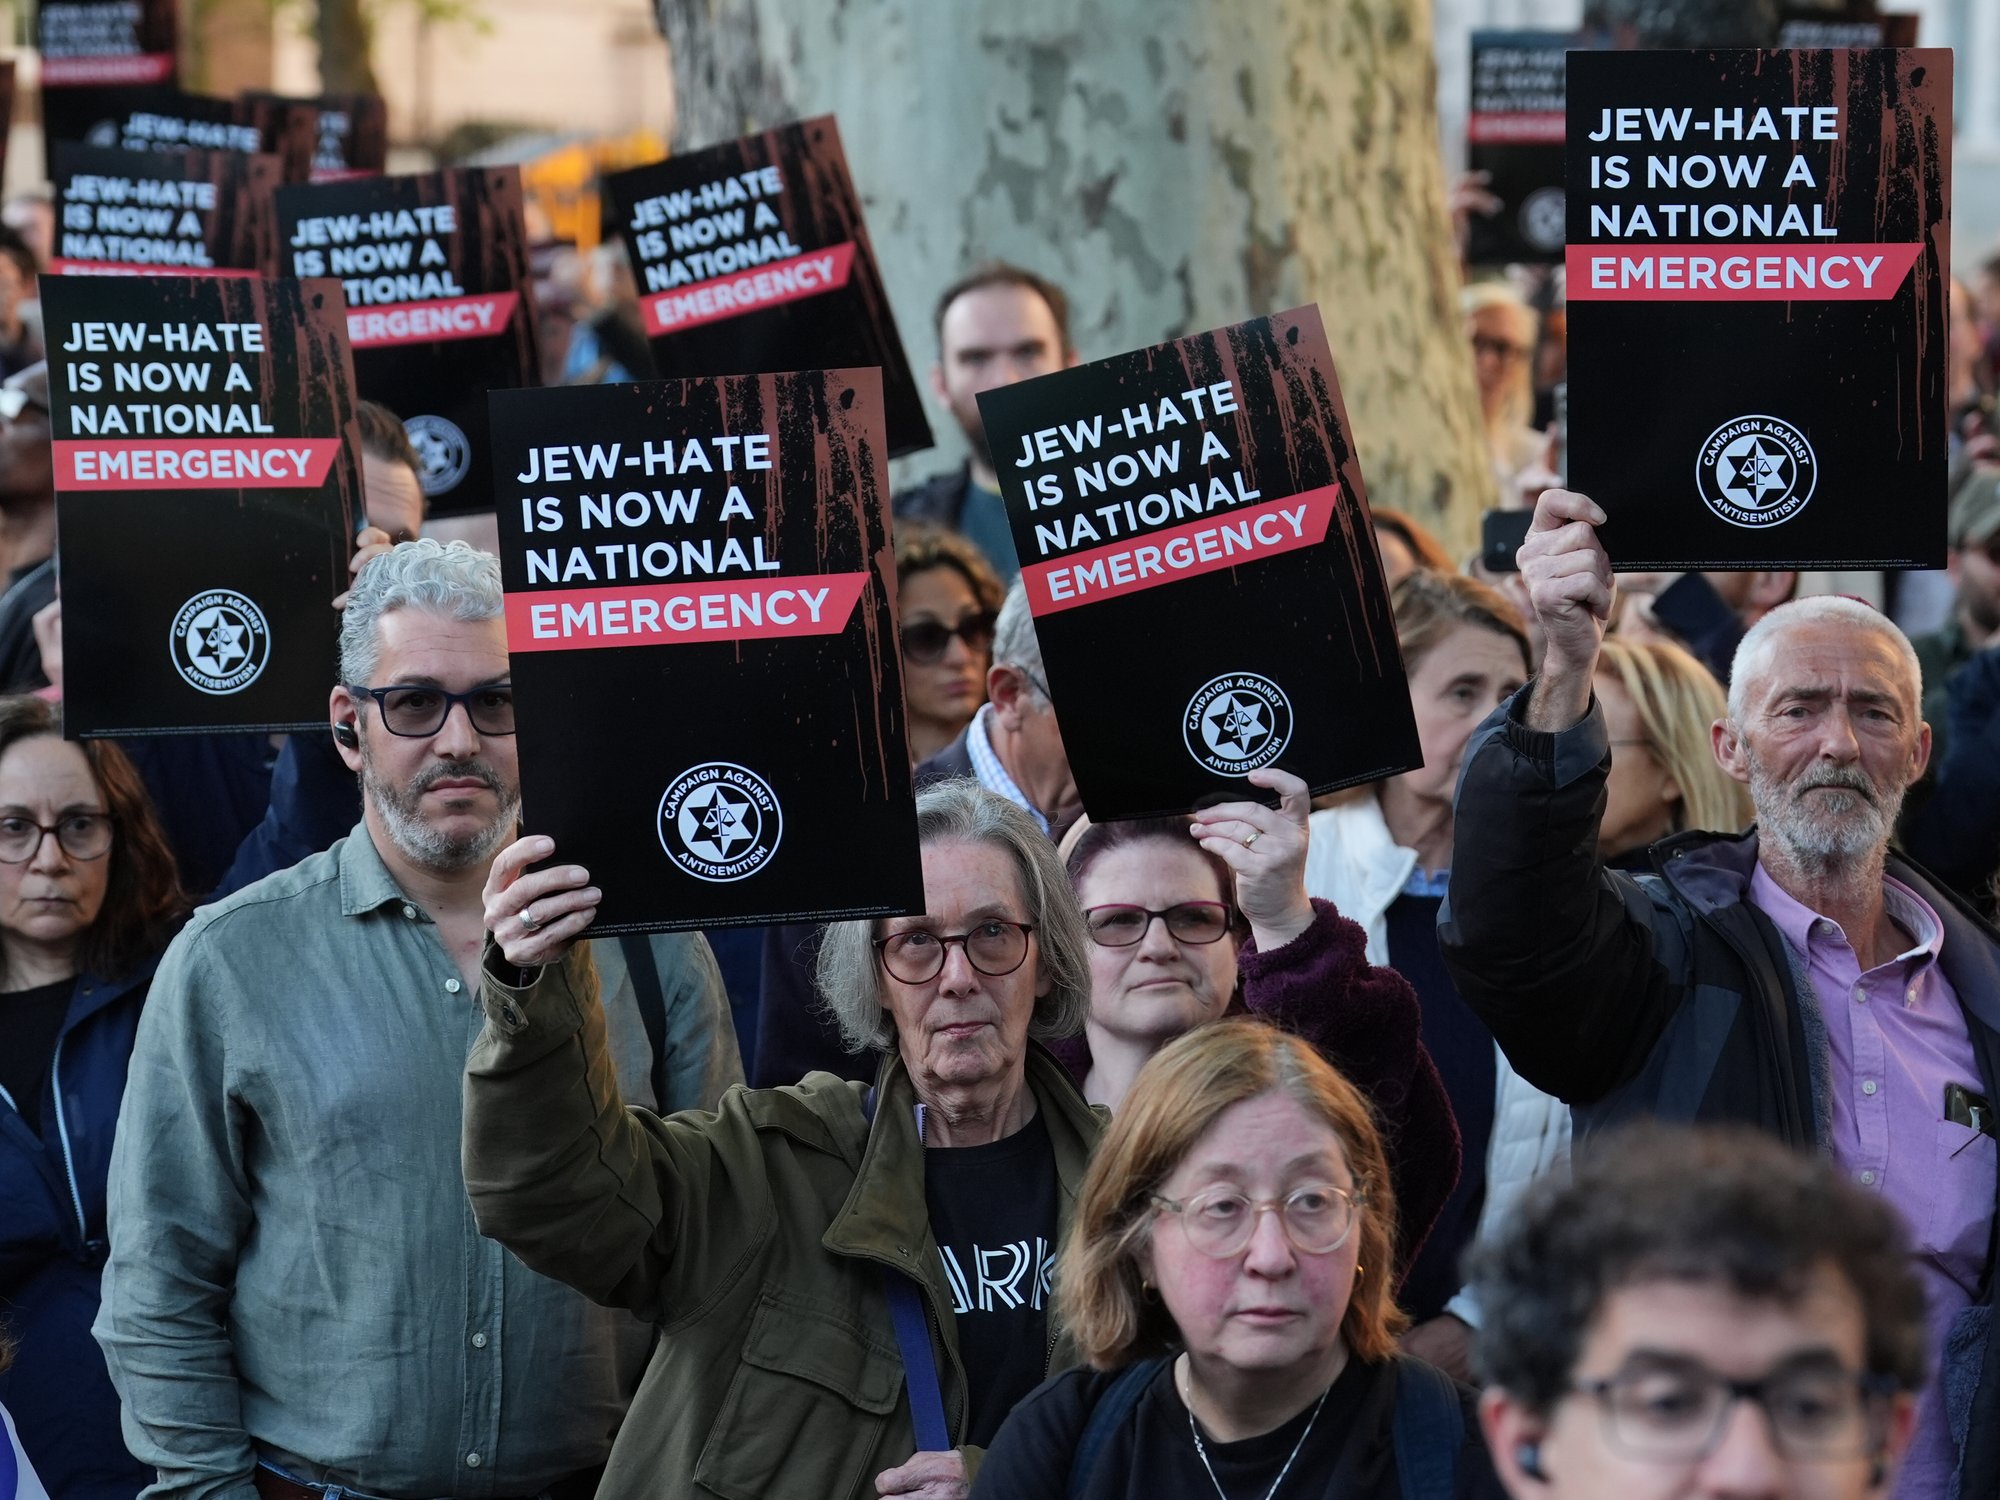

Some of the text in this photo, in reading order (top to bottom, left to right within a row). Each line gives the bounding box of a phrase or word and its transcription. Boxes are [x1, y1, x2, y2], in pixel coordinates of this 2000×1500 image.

[1588, 107, 1839, 141] JEW-HATE
[1591, 155, 1816, 188] IS NOW A
[63, 174, 218, 211] JEW-HATE
[630, 165, 783, 231] JEW-HATE
[63, 203, 202, 238] IS NOW A
[290, 204, 457, 247] JEW-HATE
[636, 201, 780, 261] IS NOW A
[1591, 204, 1838, 237] NATIONAL
[62, 232, 214, 268] NATIONAL
[293, 238, 447, 278] IS NOW A
[644, 230, 802, 292] NATIONAL
[343, 269, 464, 306] TIONAL
[654, 255, 835, 327] EMERGENCY
[1591, 256, 1884, 289] EMERGENCY
[63, 322, 265, 352] JEW-HATE
[347, 301, 496, 341] ERGENCY
[67, 362, 252, 392] IS NOW A
[70, 404, 274, 434] NATIONAL
[1015, 380, 1239, 468] JEW-HATE
[516, 434, 773, 484] JEW-HATE
[1704, 421, 1809, 467] CAMPAIGN AGAINST
[74, 449, 312, 481] EMERGENCY
[1023, 431, 1231, 511] IS NOW A
[521, 486, 754, 533] IS NOW A
[1034, 471, 1261, 555] NATIONAL
[1713, 495, 1800, 522] ANTISEMITISM
[525, 536, 780, 584] NATIONAL
[1046, 504, 1307, 601] EMERGENCY
[176, 595, 264, 638] CAMPAIGN AGAINST
[531, 587, 830, 639] EMERGENCY
[184, 662, 257, 689] ANTISEMITISM
[1189, 677, 1283, 730] CAMPAIGN AGAINST
[1205, 736, 1283, 772] ANTISEMITISM
[664, 769, 774, 819] CAMPAIGN AGAINST
[678, 845, 768, 876] ANTISEMITISM
